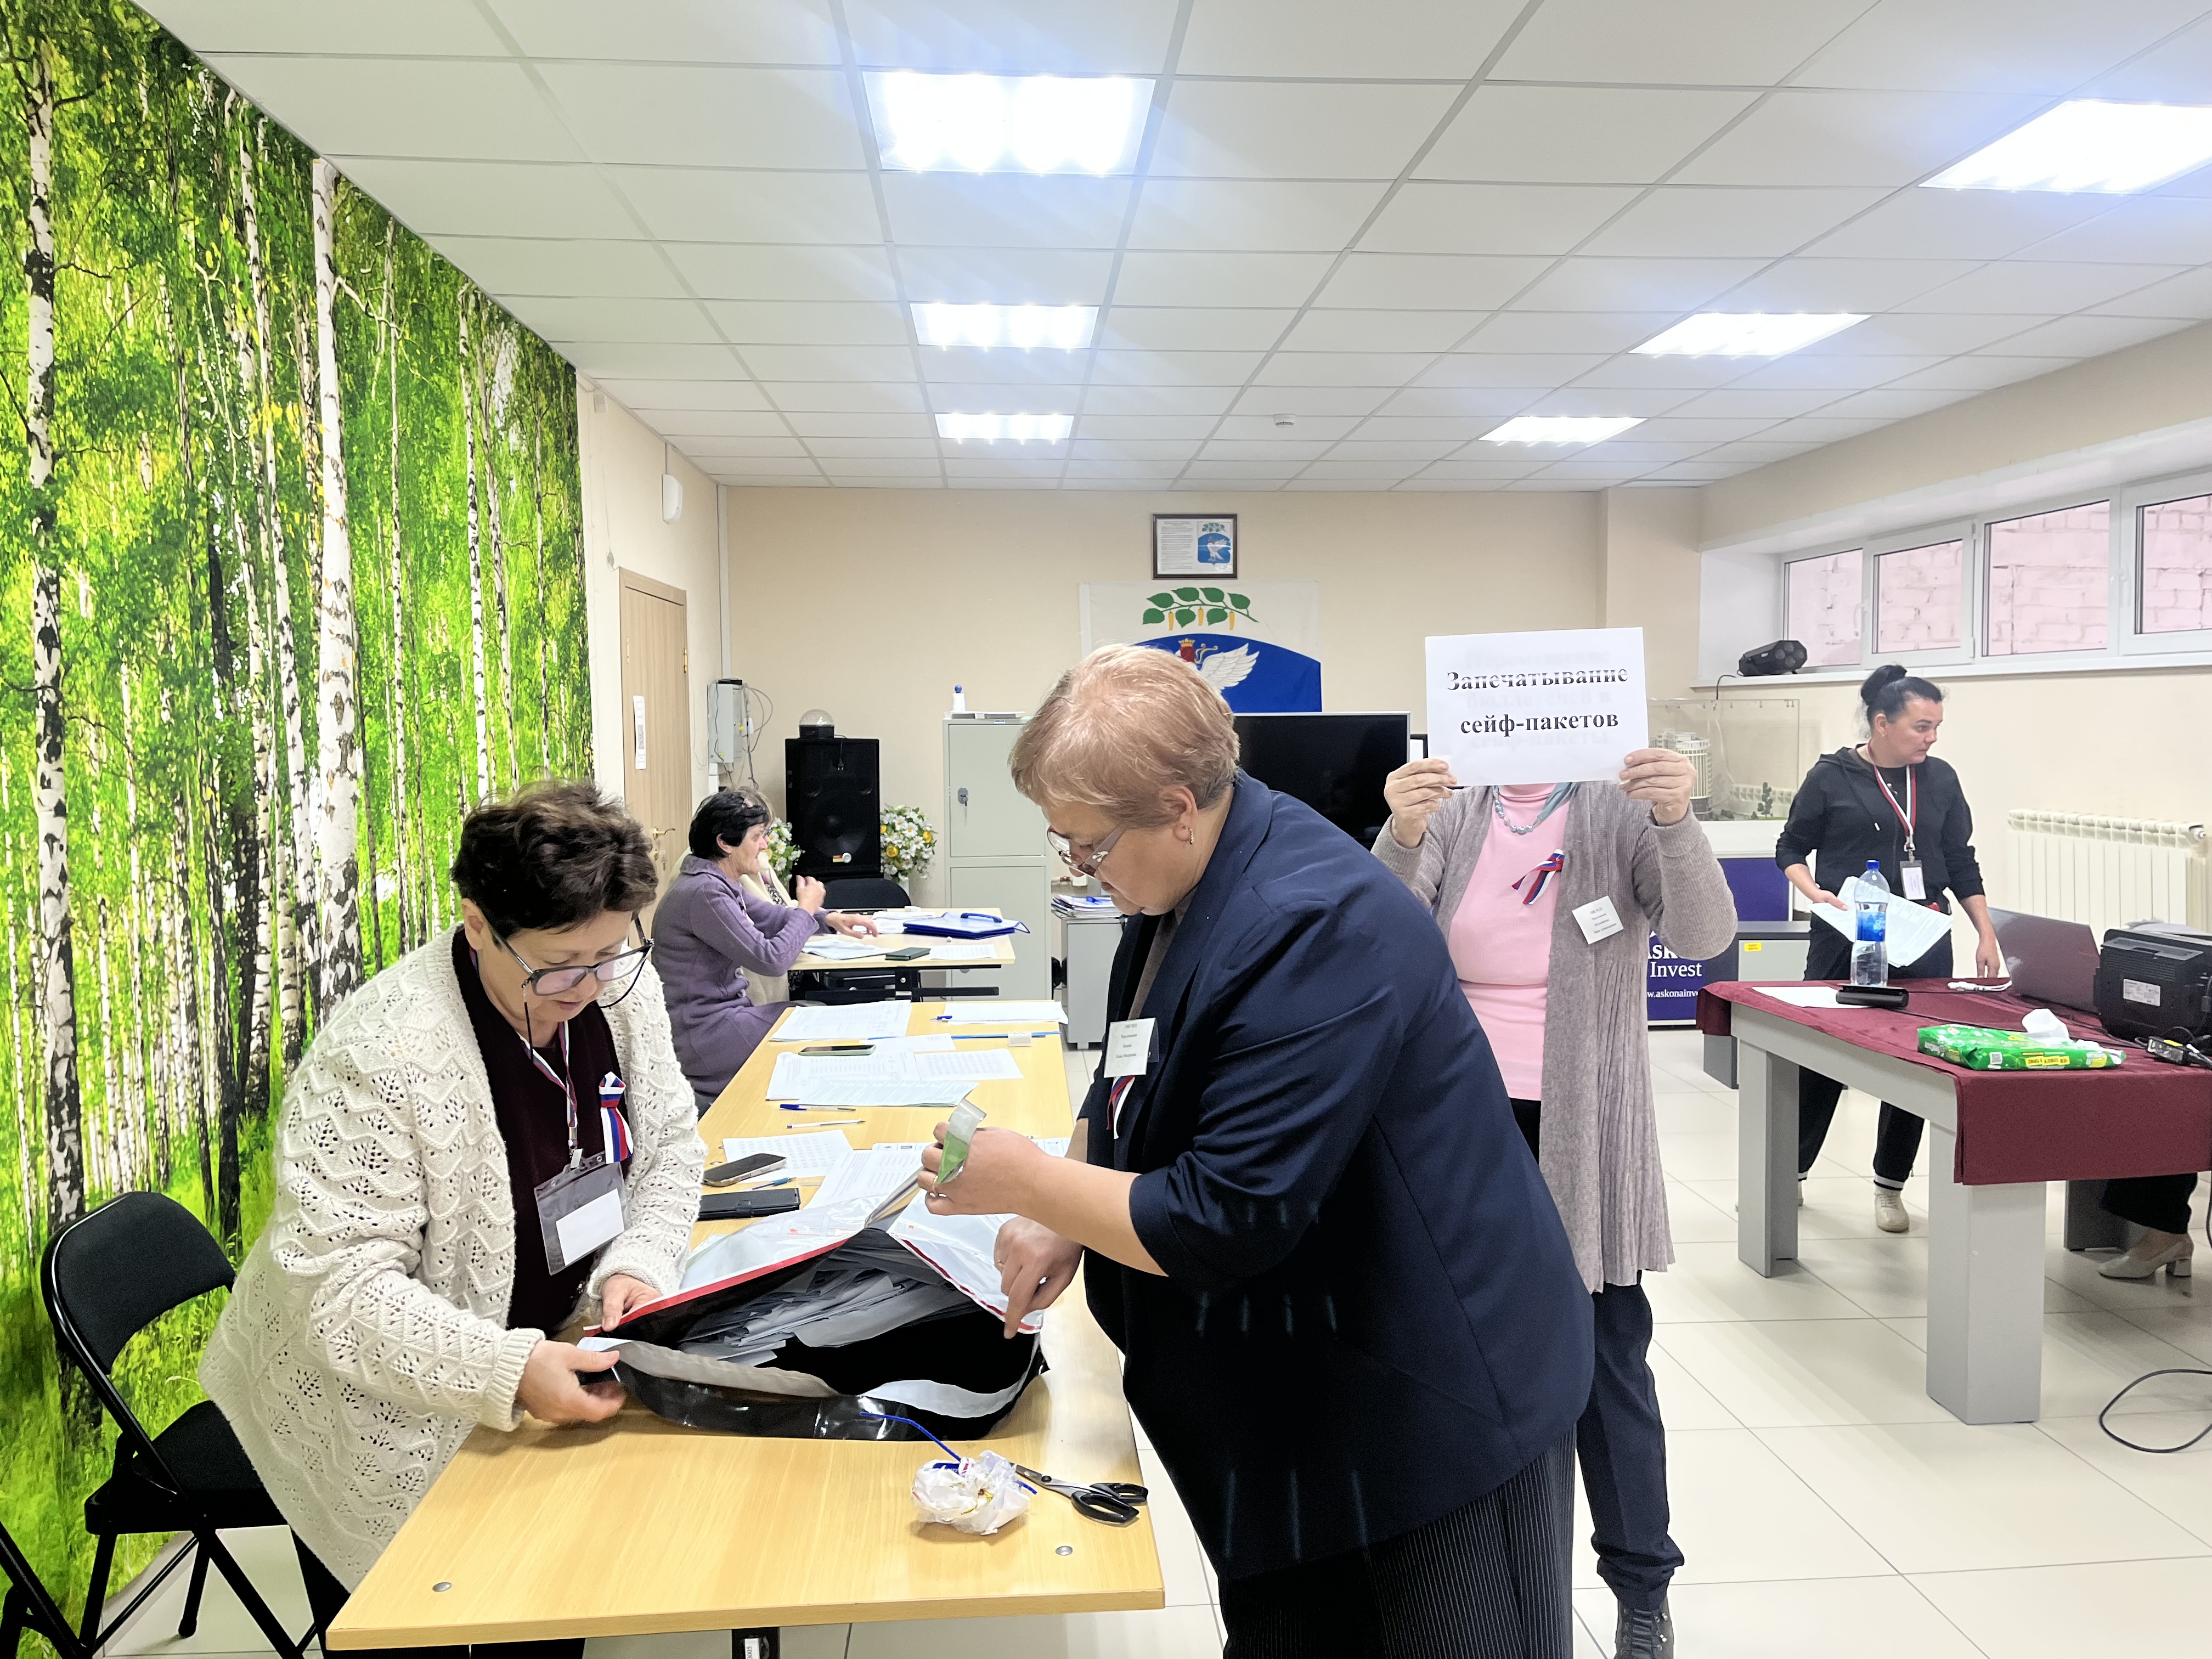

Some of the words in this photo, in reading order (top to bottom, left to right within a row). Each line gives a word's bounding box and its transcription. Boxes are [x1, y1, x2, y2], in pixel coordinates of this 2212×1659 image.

[1447, 667, 1629, 691] Запечатывание
[1460, 713, 1619, 737] сейф-пакетов
[1650, 961, 1702, 978] Invest
